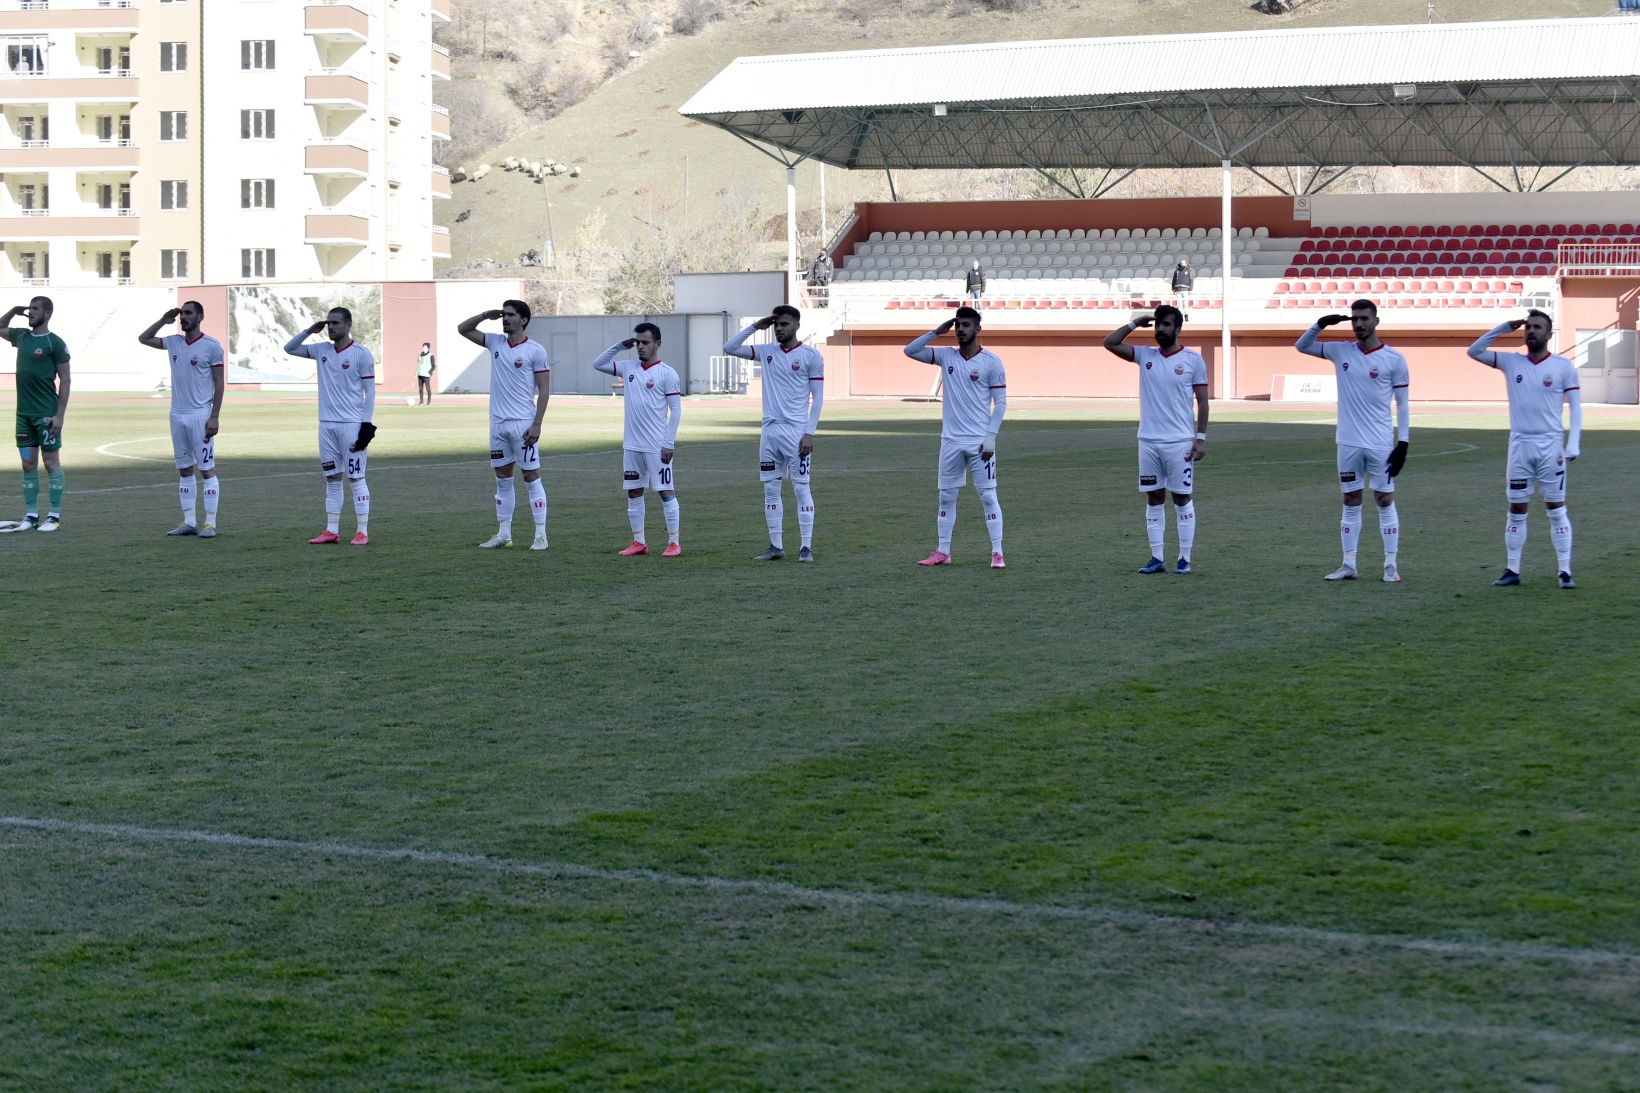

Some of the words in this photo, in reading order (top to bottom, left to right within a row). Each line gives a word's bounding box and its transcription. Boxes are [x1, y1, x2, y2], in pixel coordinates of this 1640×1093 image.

[202, 446, 214, 463] 24
[522, 446, 536, 463] 72
[348, 458, 360, 475] 54
[658, 467, 671, 485] 10
[1183, 468, 1191, 487] 3
[1555, 470, 1565, 491] 7
[1383, 527, 1397, 535] LEO
